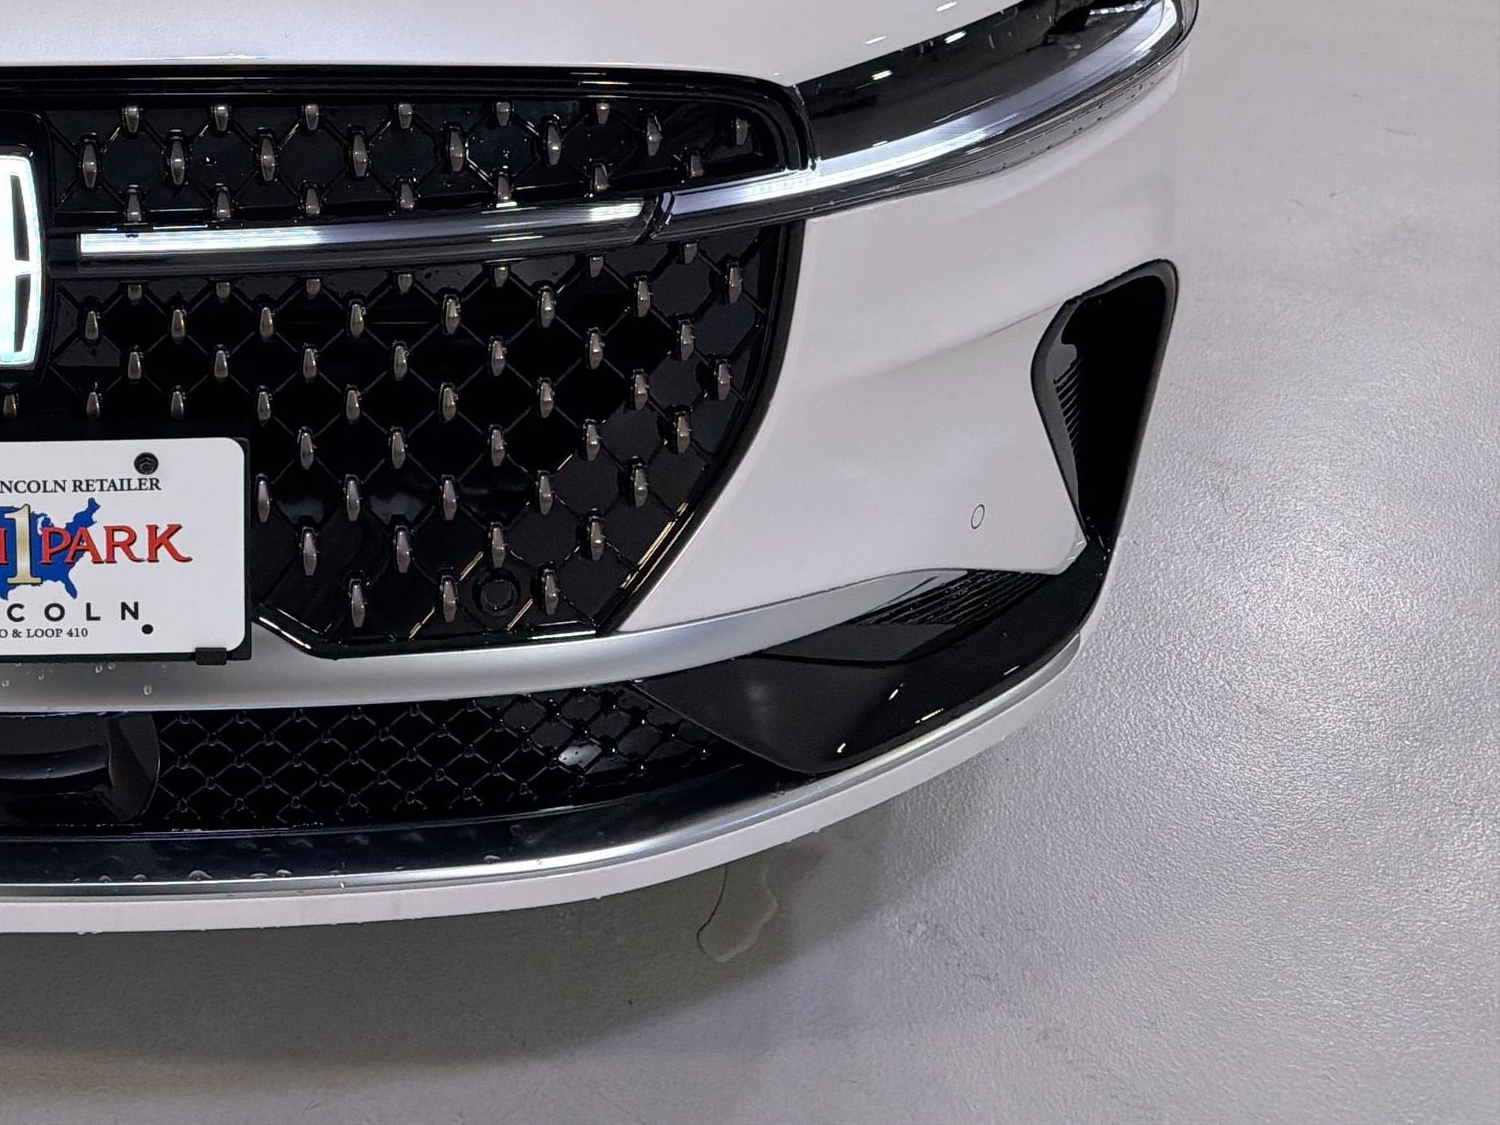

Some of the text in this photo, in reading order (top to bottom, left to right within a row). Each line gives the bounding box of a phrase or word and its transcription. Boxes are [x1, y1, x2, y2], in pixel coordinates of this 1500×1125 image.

[71, 478, 162, 493] RETAILER
[40, 523, 193, 565] PARK
[11, 628, 23, 639] &
[26, 628, 63, 639] LOOP
[66, 627, 89, 638] 410
